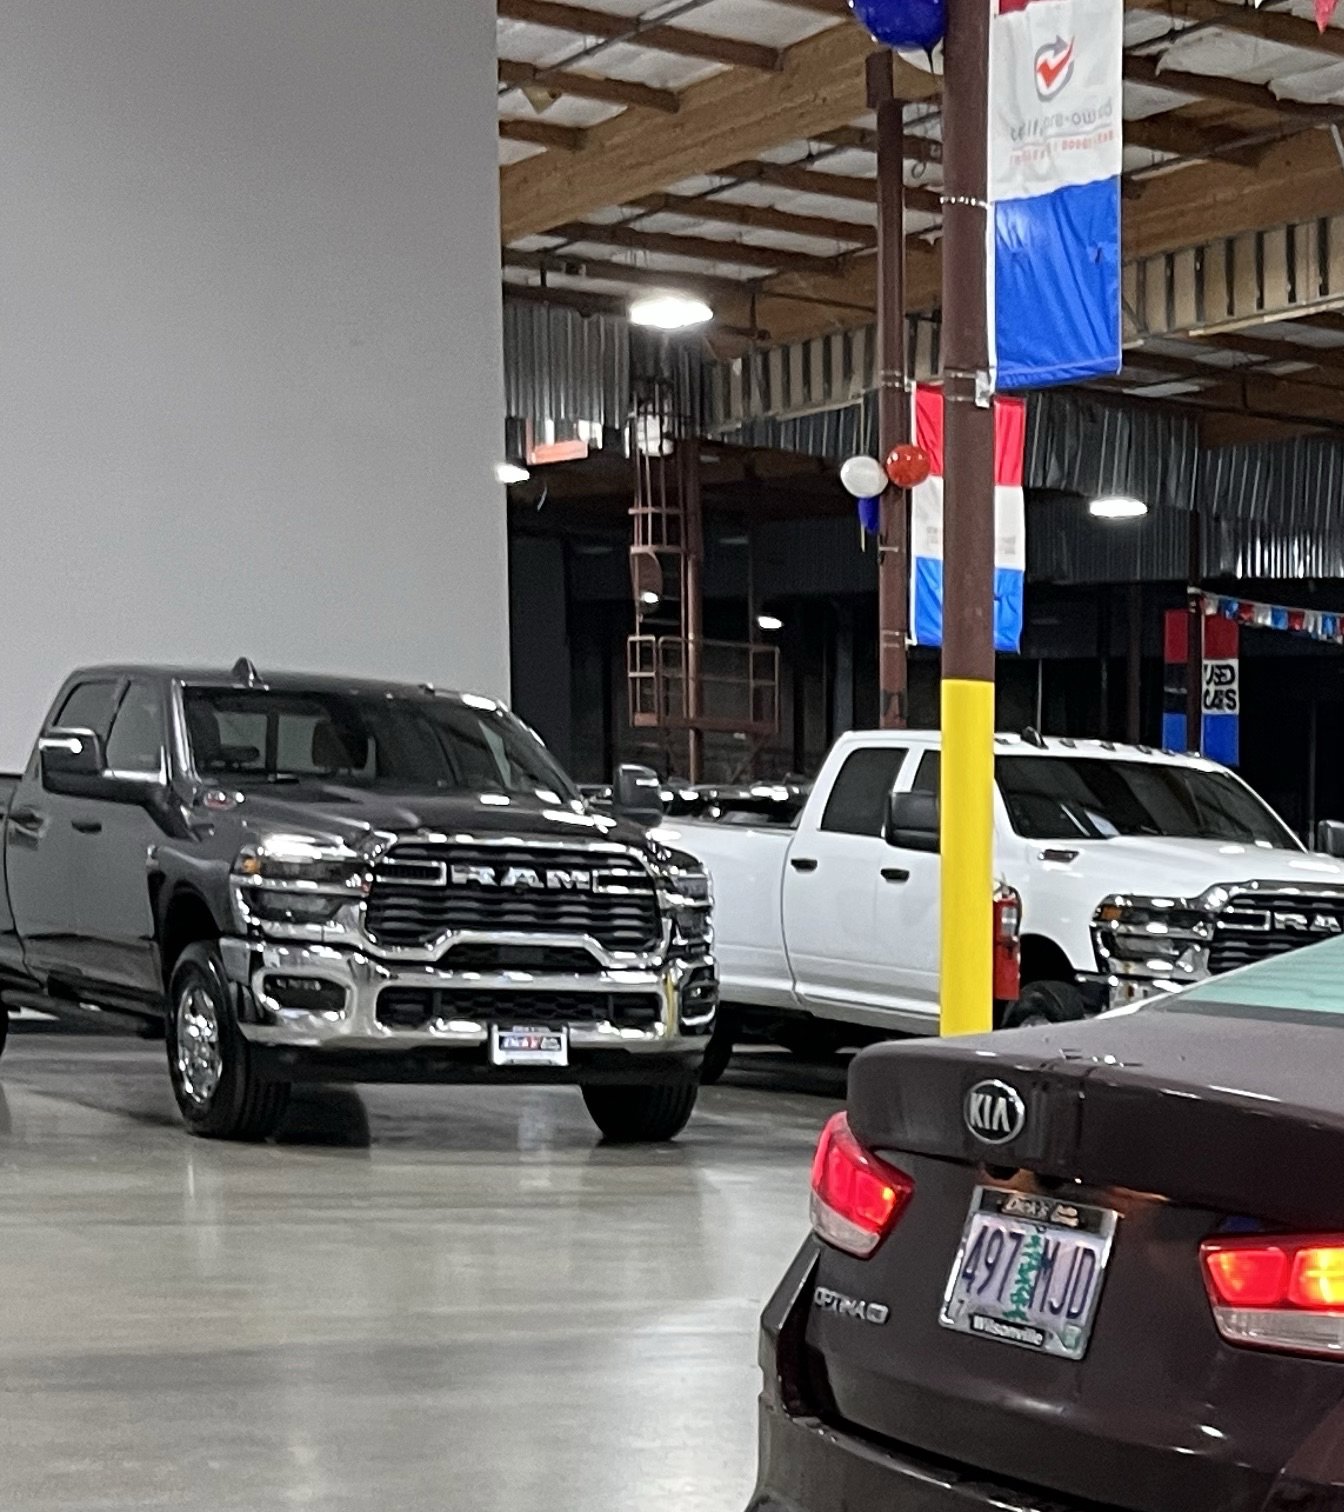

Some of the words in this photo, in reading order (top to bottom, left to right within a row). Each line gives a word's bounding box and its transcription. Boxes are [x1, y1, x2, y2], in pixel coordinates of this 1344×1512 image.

[451, 864, 594, 890] RAM
[970, 1092, 1011, 1132] KIA
[961, 1225, 1025, 1301] 497
